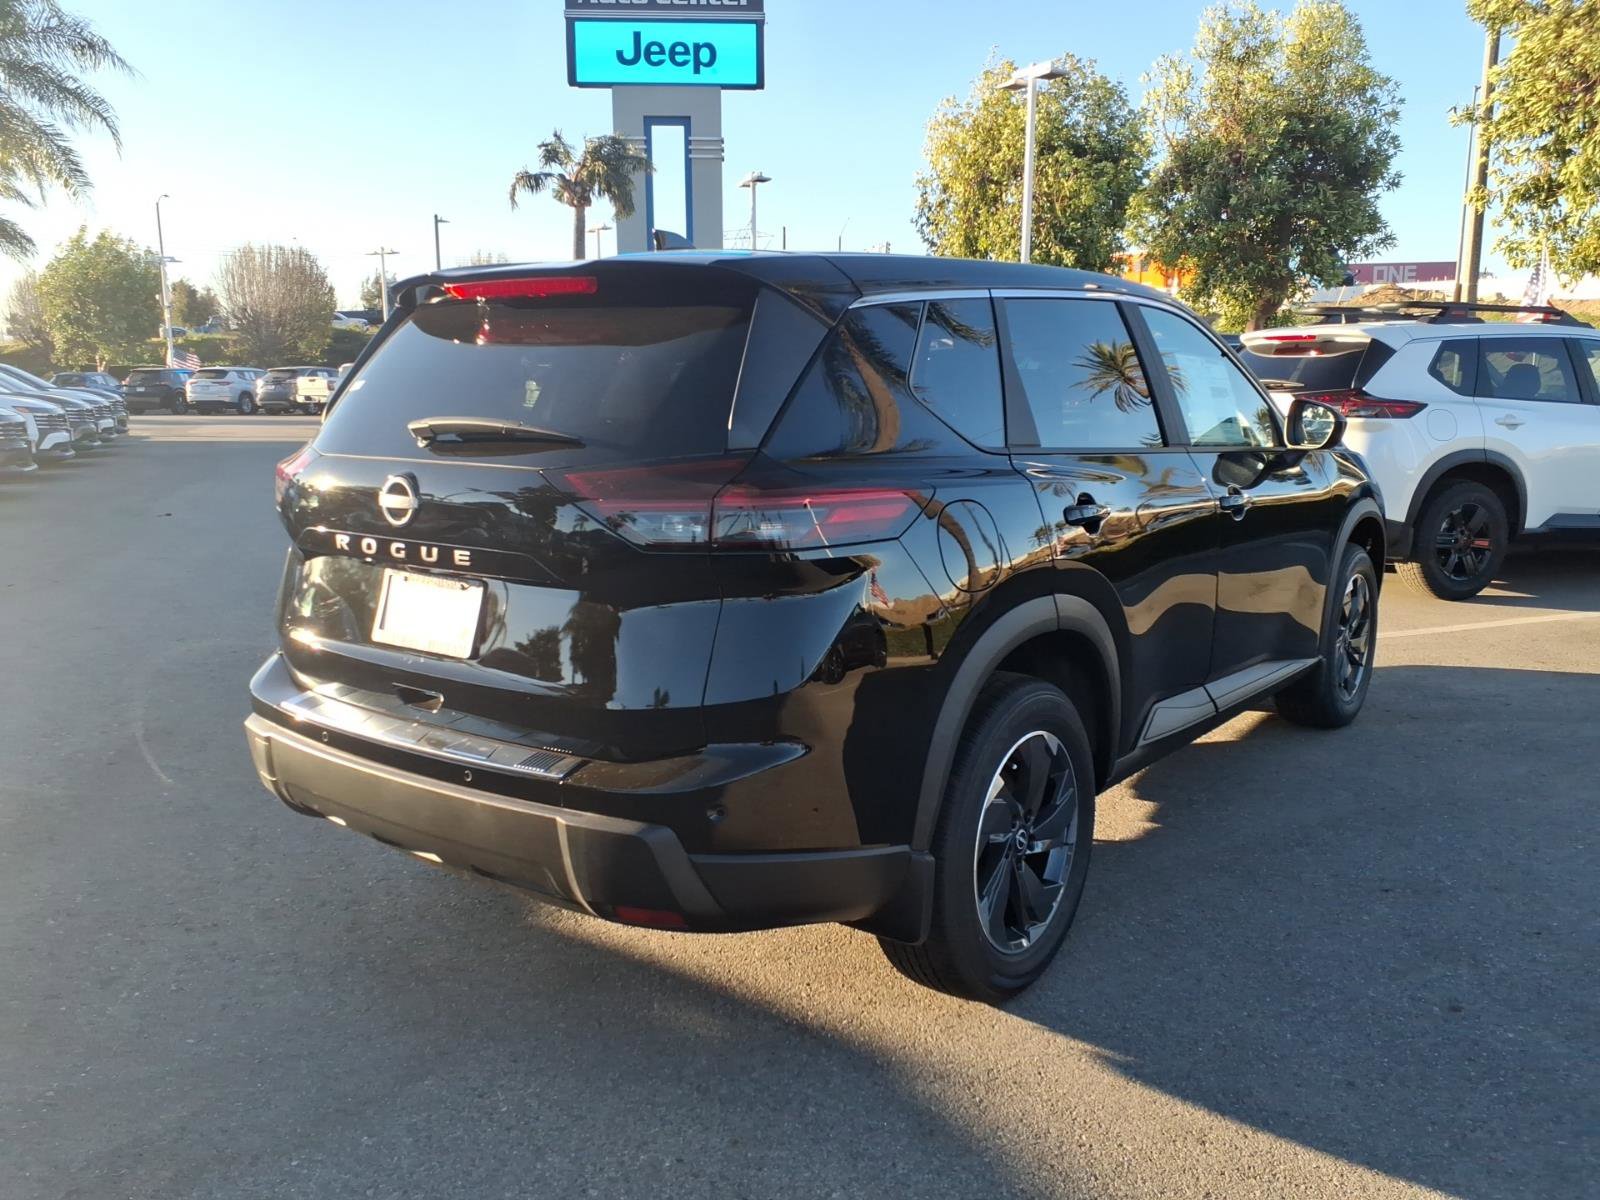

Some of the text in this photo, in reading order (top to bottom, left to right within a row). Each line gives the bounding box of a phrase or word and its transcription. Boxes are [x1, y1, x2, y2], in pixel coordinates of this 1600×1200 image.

[616, 31, 717, 74] Jeep
[1373, 265, 1417, 283] ONE
[335, 534, 472, 566] ROGUE
